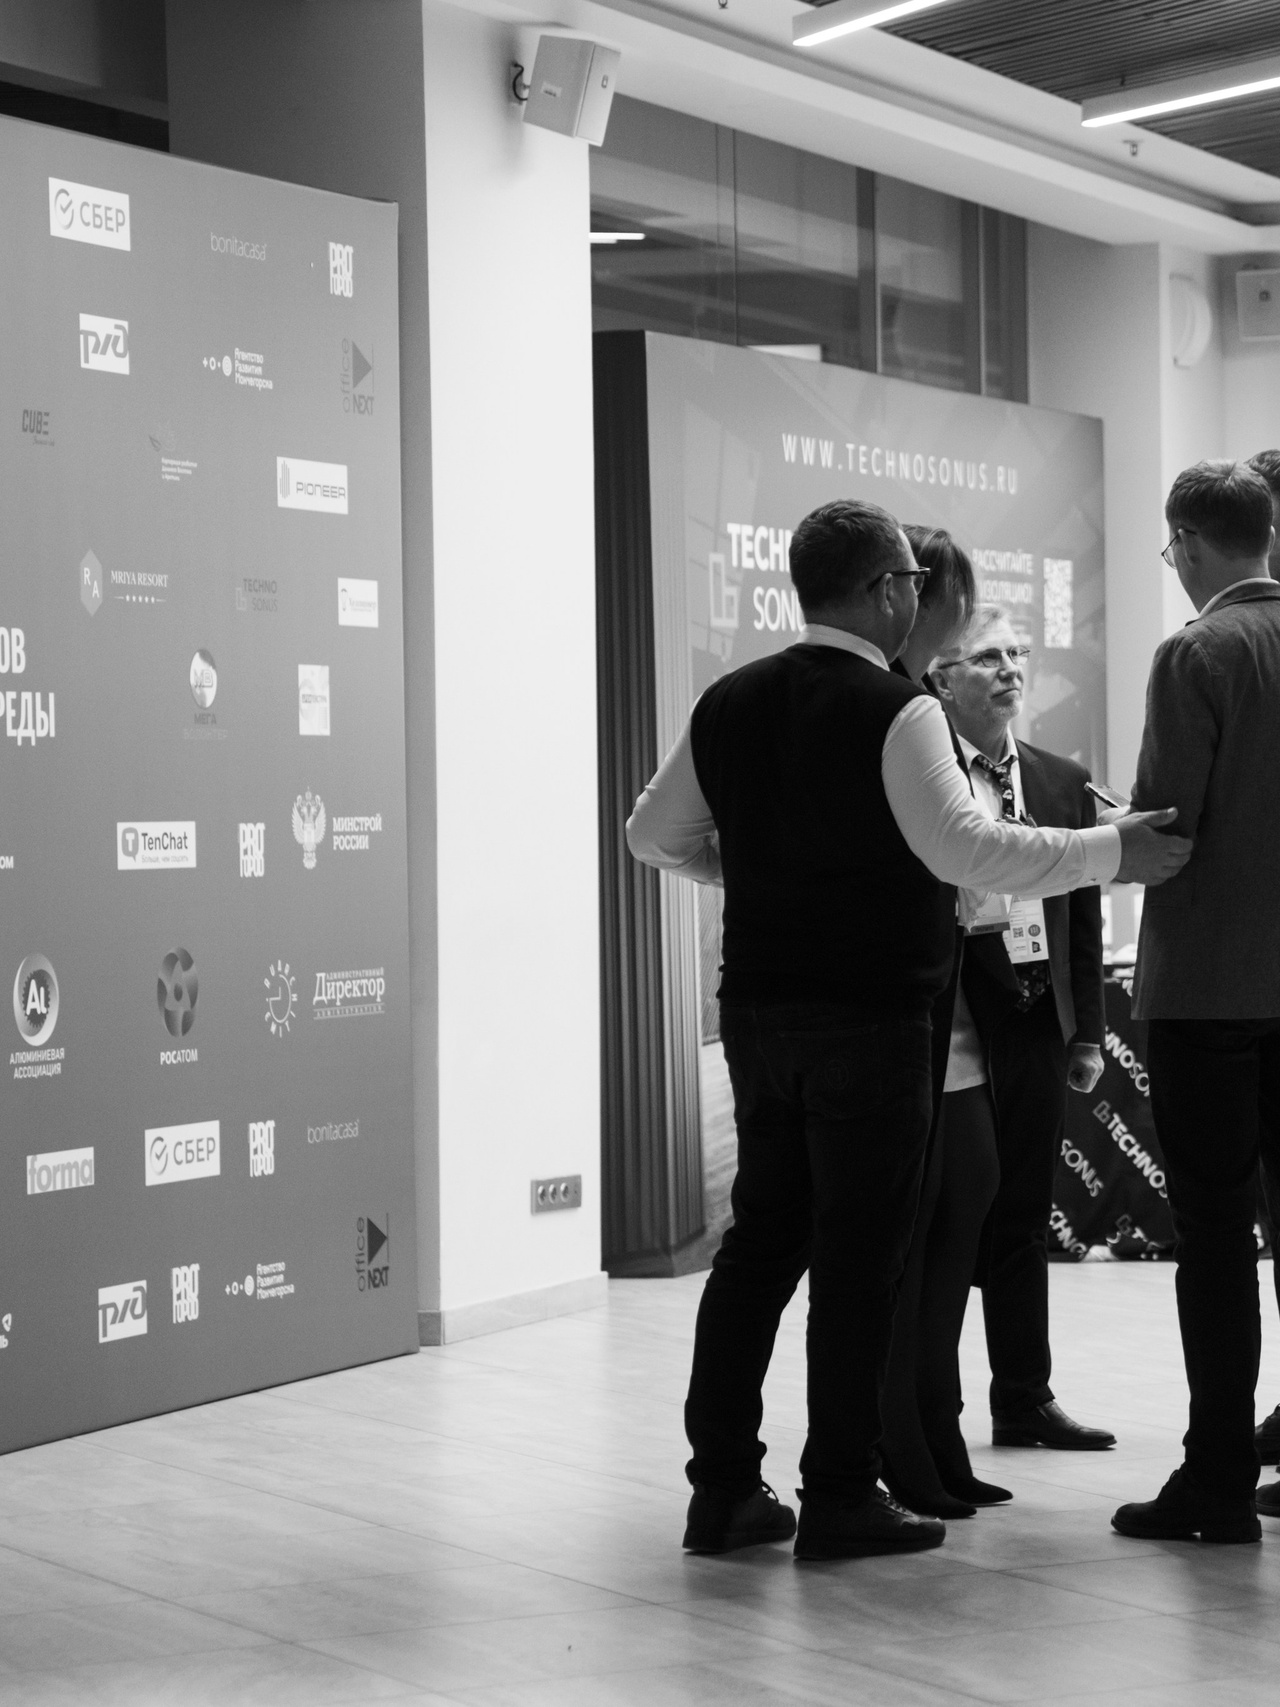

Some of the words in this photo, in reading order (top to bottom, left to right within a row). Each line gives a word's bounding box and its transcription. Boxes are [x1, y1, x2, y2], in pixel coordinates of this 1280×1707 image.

[79, 200, 126, 233] СБЕР
[210, 231, 267, 261] bonitacasa
[22, 409, 50, 435] CUBE
[781, 432, 1019, 496] WWW.TECHNOSONUS.RU
[296, 481, 346, 499] PIONEER
[110, 570, 137, 585] MRIYA
[137, 572, 169, 588] RESORT
[242, 578, 278, 594] TECHNO
[252, 598, 278, 612] SONUS
[332, 813, 382, 832] МИНСТРОЙ
[141, 831, 188, 851] TenChat
[333, 835, 369, 851] РОССИИ
[312, 972, 385, 1006] Директор
[9, 1048, 65, 1065] АЛЮМИНИЕВАЯ
[160, 1048, 199, 1066] РОСАТОМ
[13, 1063, 61, 1080] АССОЦИАЦИЯ
[307, 1119, 360, 1144] bonitacasa
[173, 1136, 216, 1166] СБЕР
[29, 1155, 93, 1194] forma
[367, 1265, 389, 1290] NEXT
